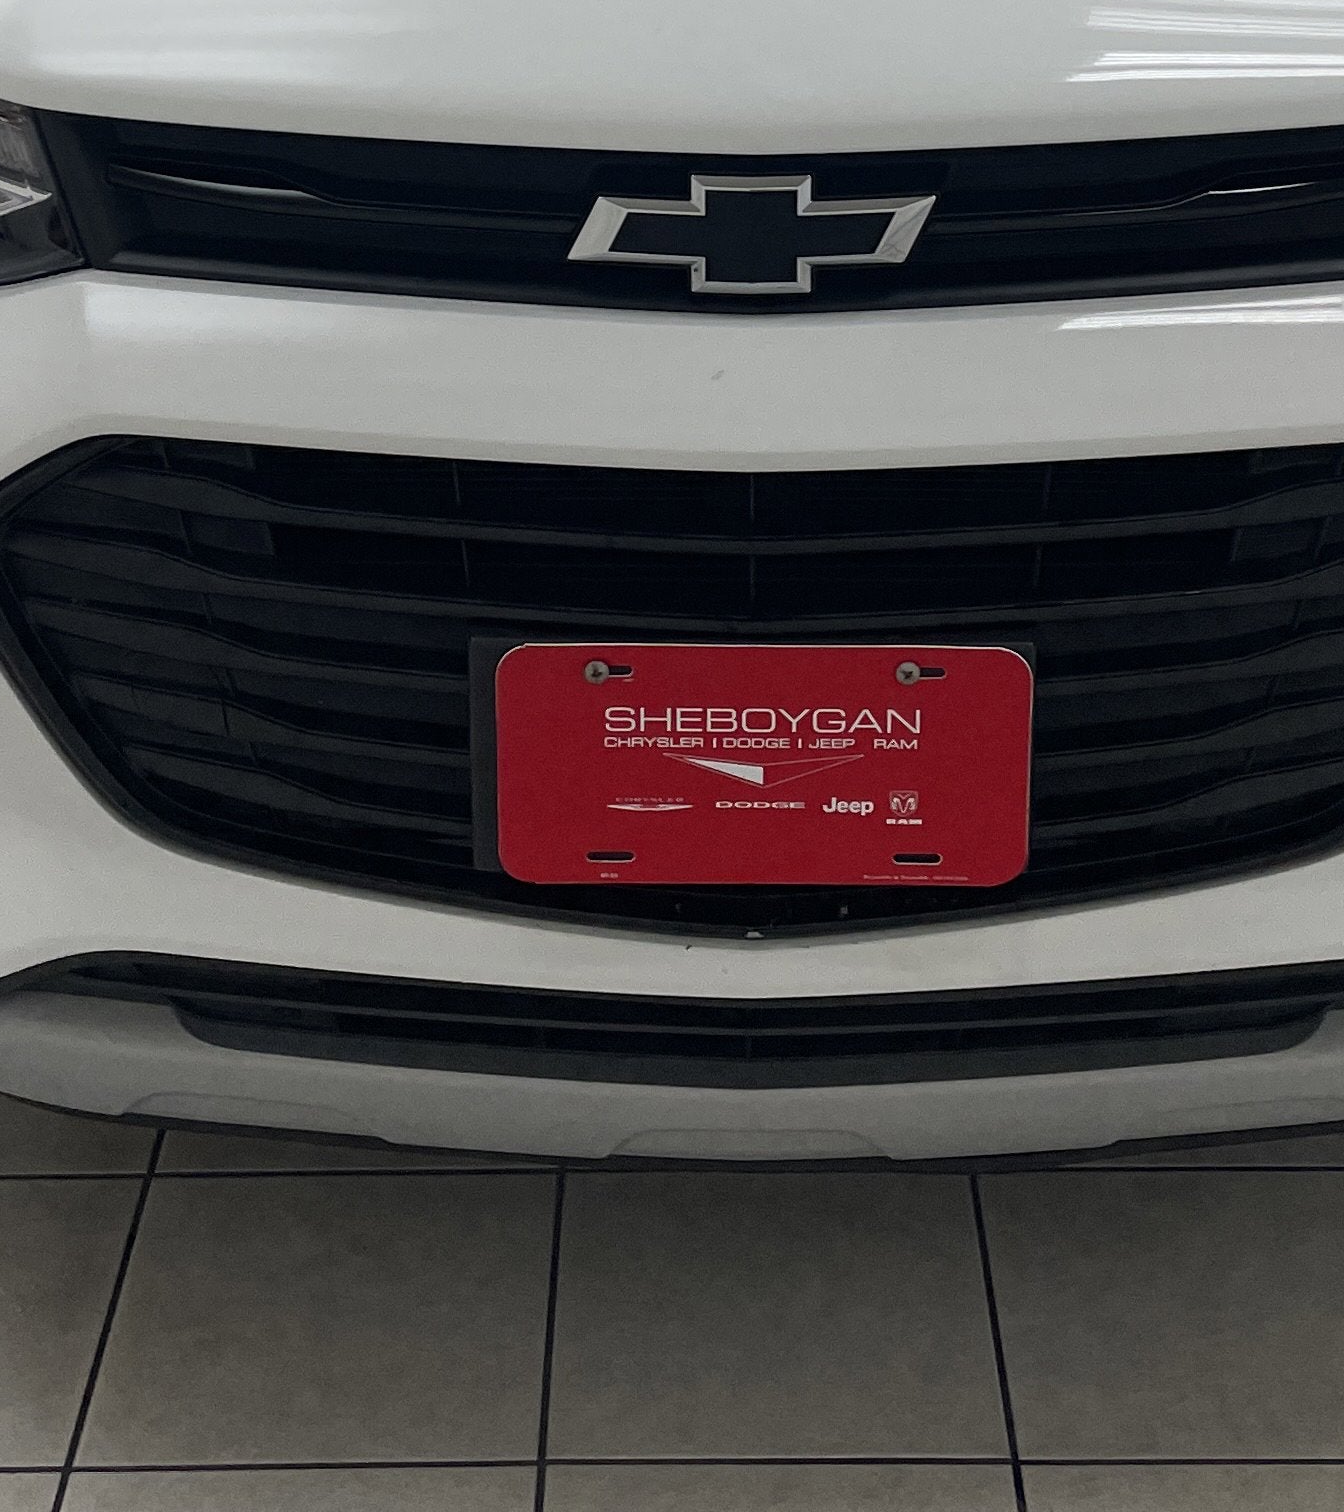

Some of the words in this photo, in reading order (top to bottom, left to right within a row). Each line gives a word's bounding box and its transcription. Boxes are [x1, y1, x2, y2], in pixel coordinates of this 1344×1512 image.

[604, 706, 921, 734] SHEBOYGAN
[604, 736, 704, 748] CHRYSLER
[722, 737, 791, 749] DODGE
[808, 738, 856, 749] JEEP
[873, 738, 918, 750] RAM
[715, 800, 806, 809] DODGE
[822, 796, 875, 816] Jeep
